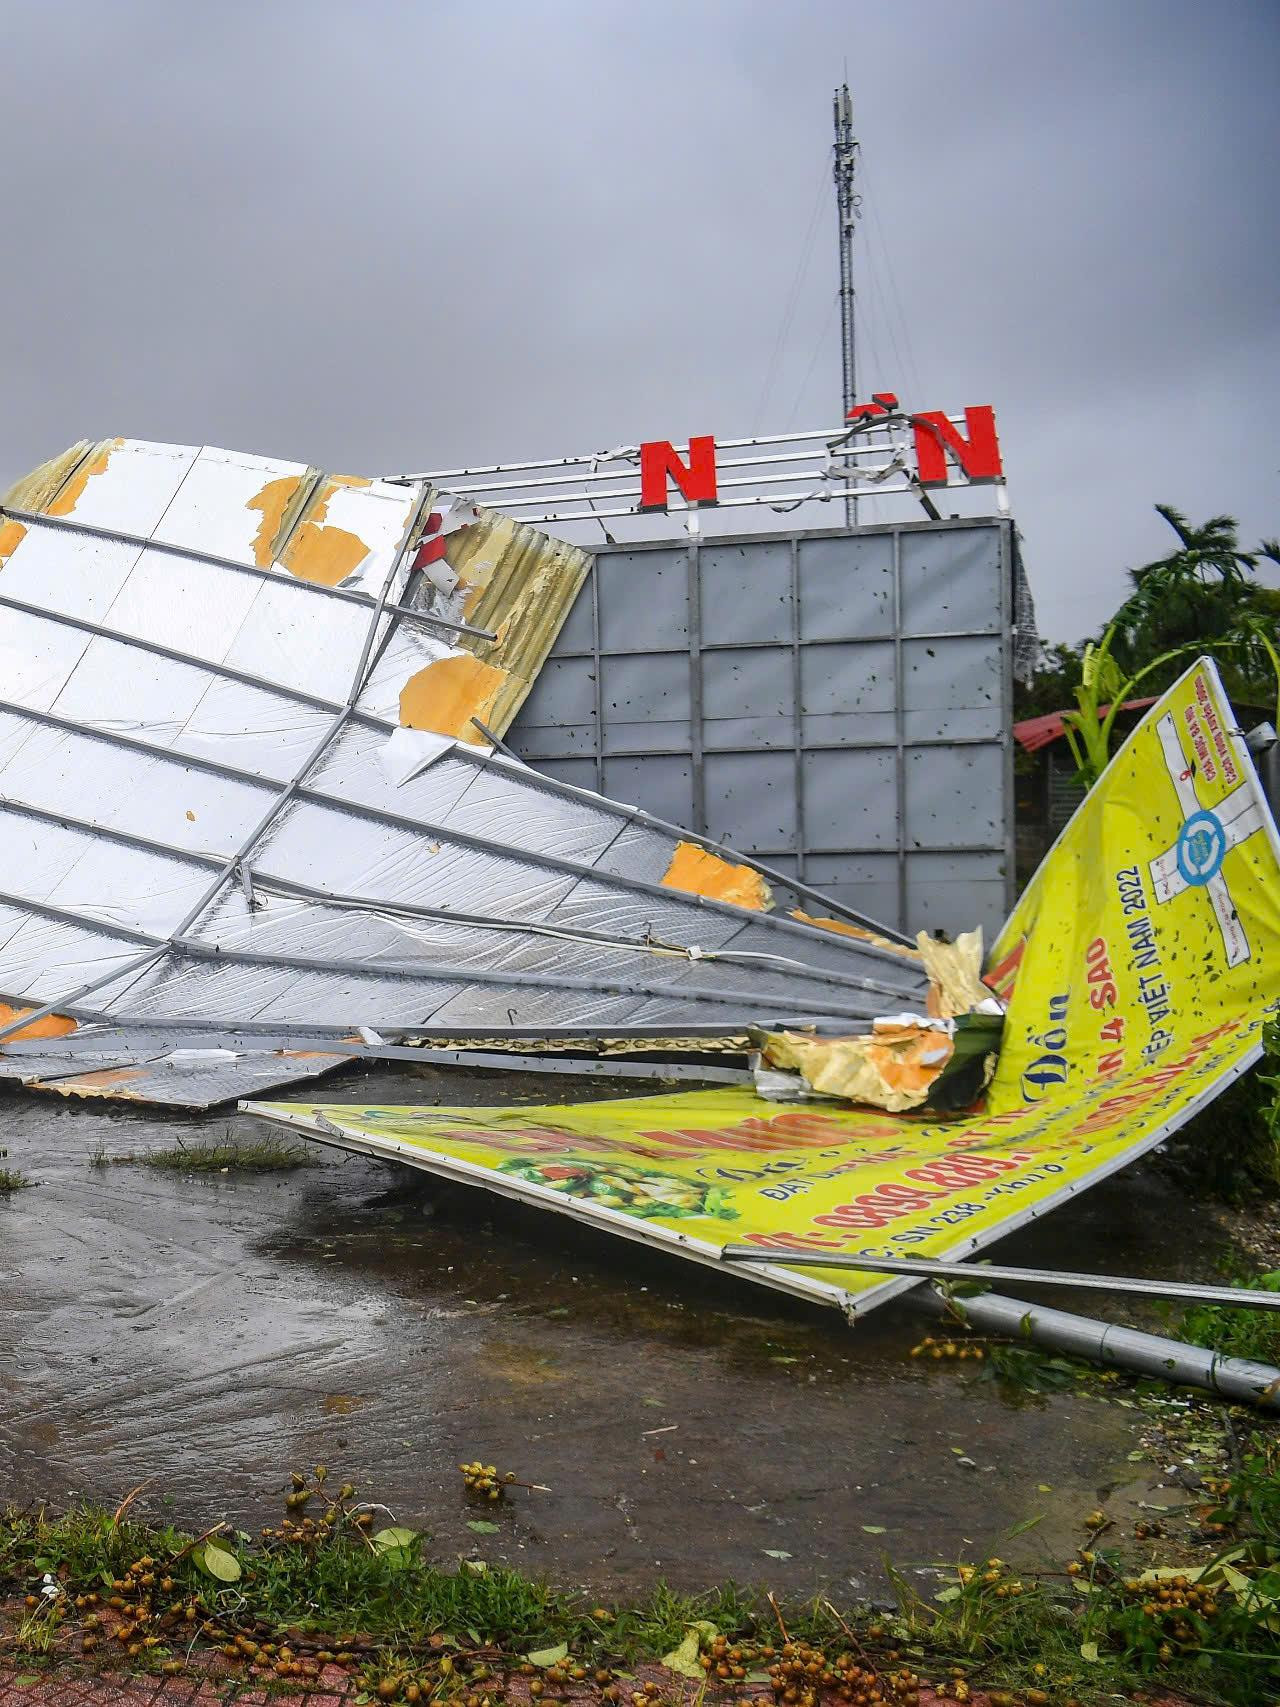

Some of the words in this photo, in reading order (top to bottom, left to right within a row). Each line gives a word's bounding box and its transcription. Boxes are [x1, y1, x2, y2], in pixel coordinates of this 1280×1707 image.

[1116, 866, 1146, 915] 2022
[1127, 917, 1158, 969] NAM
[1087, 938, 1118, 1010] SAO
[1137, 973, 1172, 1027] VIỆT
[1099, 1017, 1124, 1041] 4
[929, 1201, 987, 1225] 238
